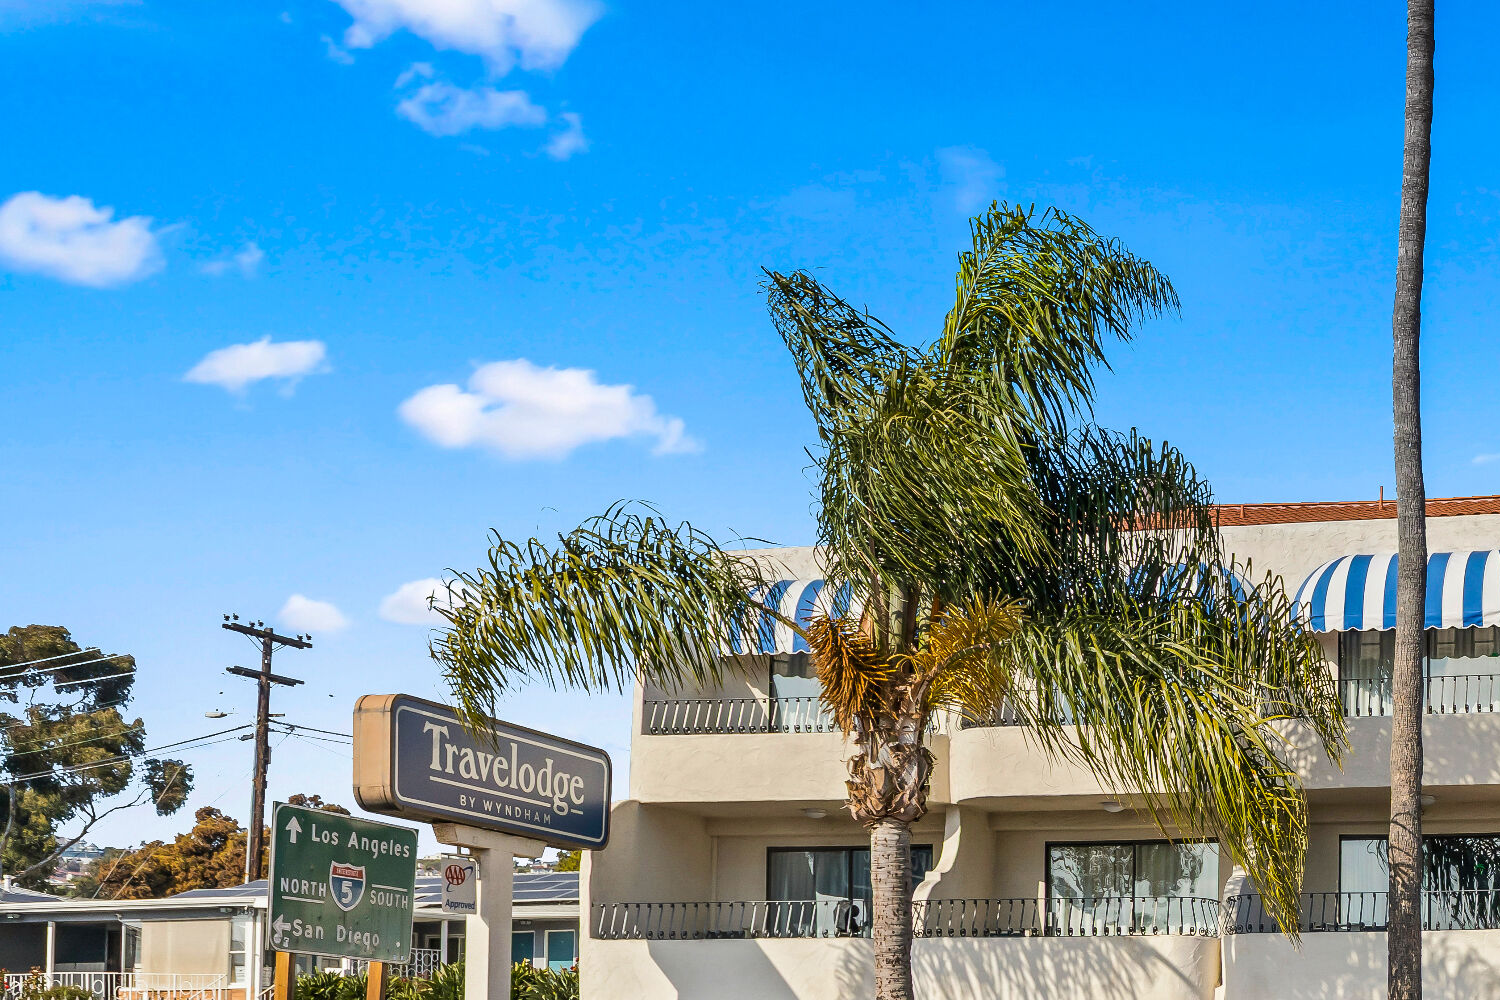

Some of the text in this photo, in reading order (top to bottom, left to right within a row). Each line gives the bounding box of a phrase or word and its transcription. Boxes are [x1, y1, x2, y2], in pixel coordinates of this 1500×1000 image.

[423, 720, 585, 816] Travelodge
[459, 794, 551, 824] BY WYNDHAM
[311, 823, 410, 859] Los Angeles
[280, 877, 327, 898] NORTH
[445, 865, 466, 886] AAA
[341, 880, 353, 904] 5
[370, 890, 409, 910] SOUTH
[445, 899, 476, 910] Approved
[292, 918, 380, 948] San Diego
